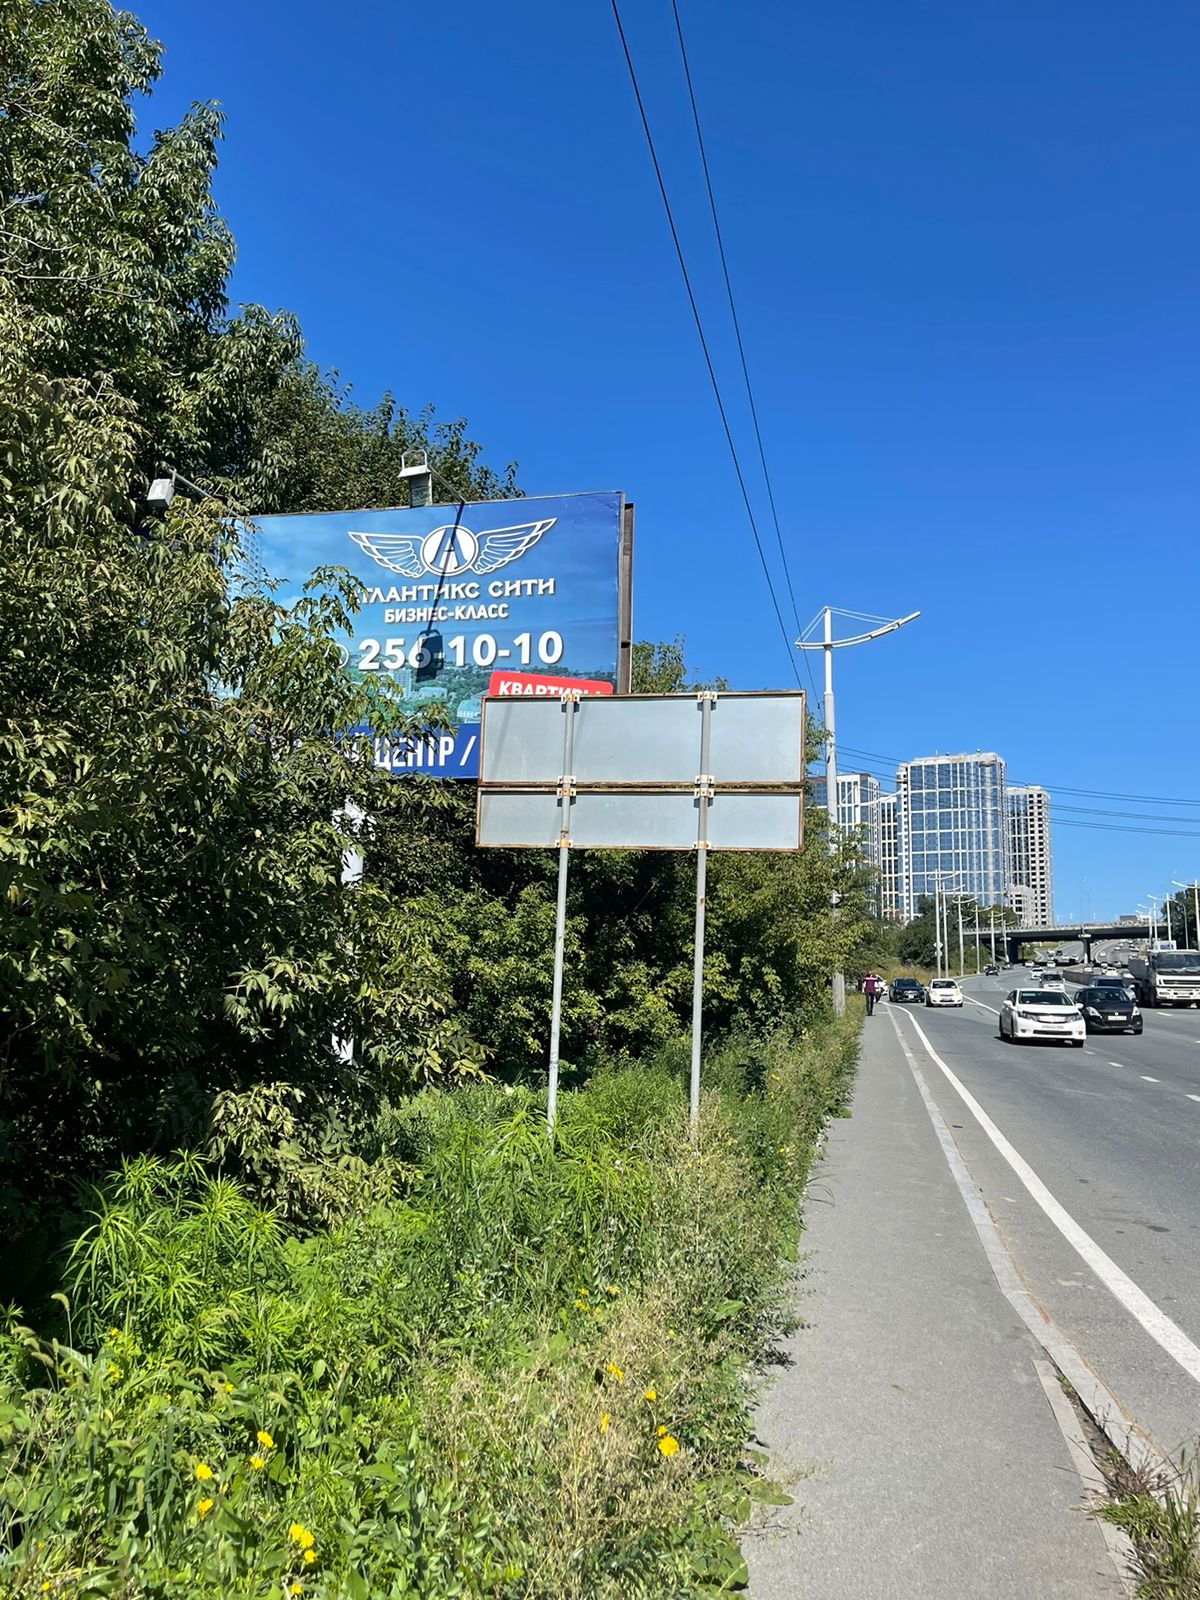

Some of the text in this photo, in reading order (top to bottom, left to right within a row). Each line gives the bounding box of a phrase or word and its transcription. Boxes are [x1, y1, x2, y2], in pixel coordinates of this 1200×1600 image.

[488, 578, 555, 597] СИТИ
[384, 603, 509, 624] БИЗНЕС-КЛАСС
[358, 630, 563, 670] 256-10-10
